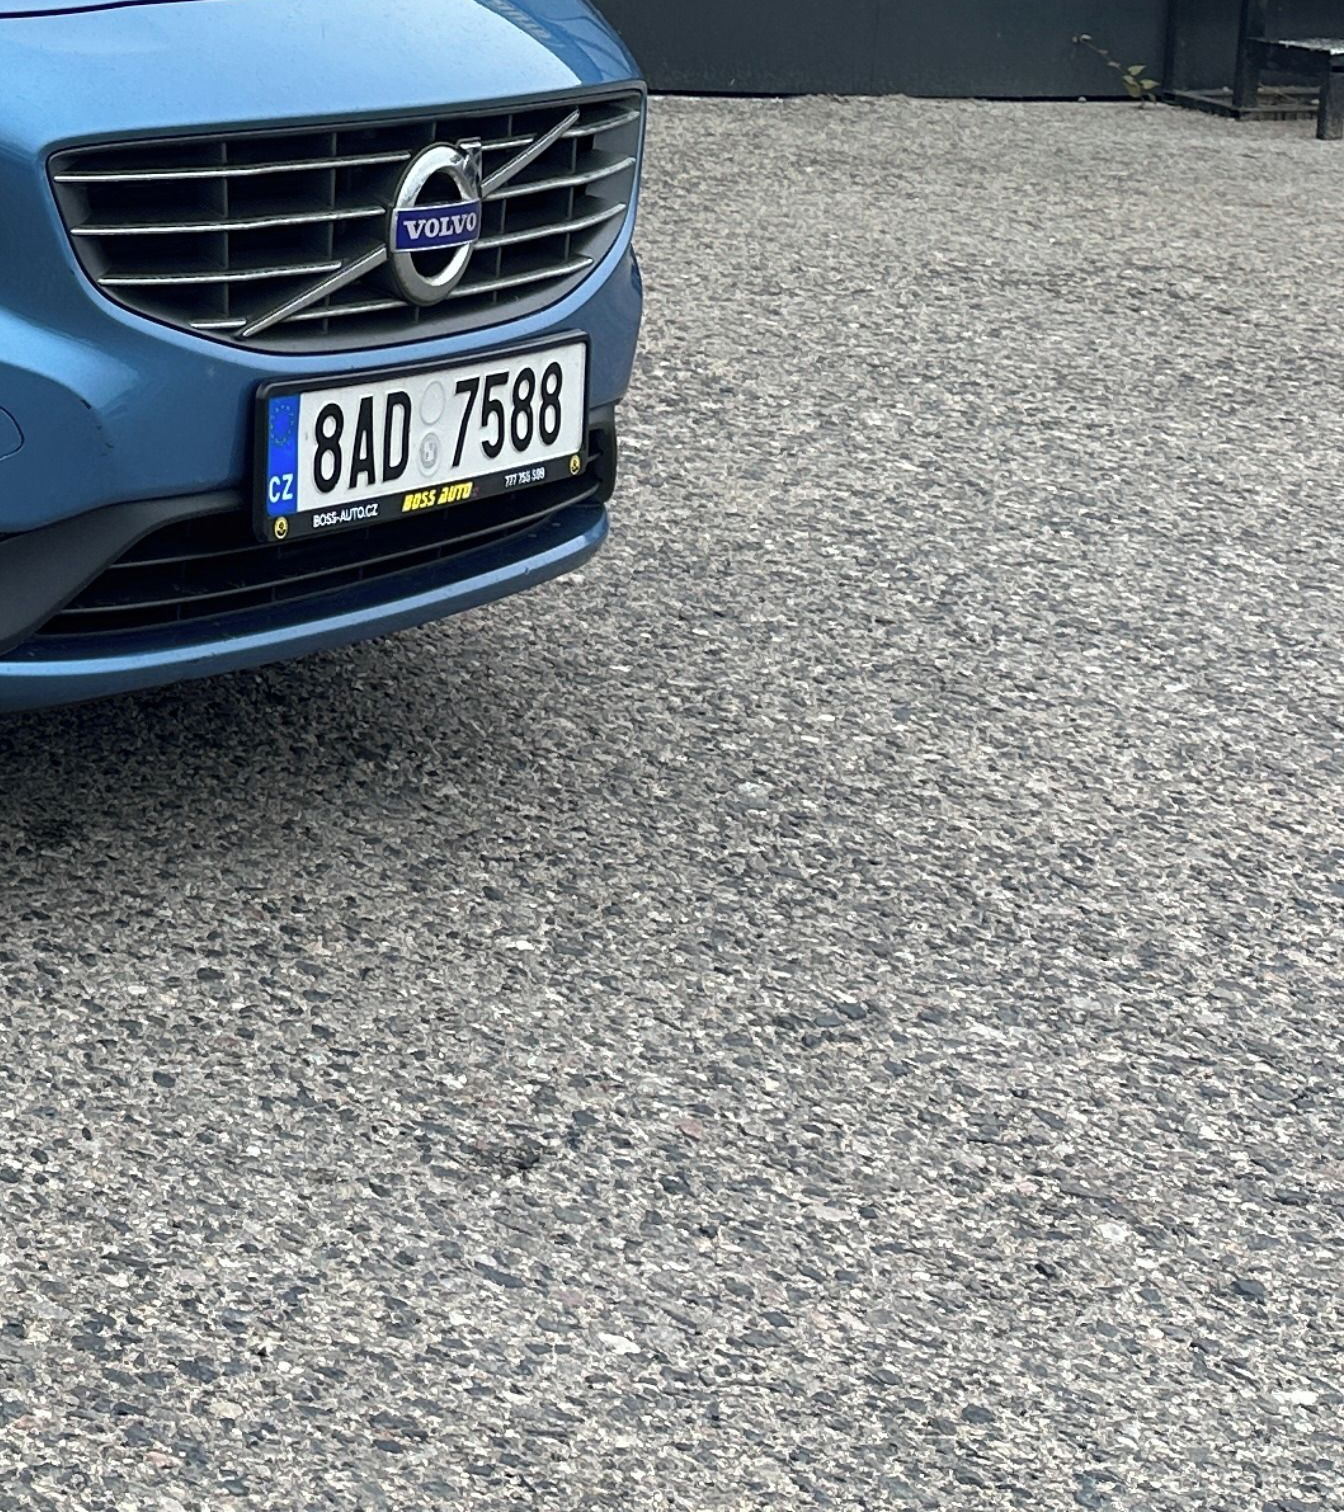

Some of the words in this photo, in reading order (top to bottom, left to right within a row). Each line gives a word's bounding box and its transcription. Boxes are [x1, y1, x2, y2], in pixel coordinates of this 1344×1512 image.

[402, 212, 477, 240] VOLVO
[313, 390, 412, 494] 8AD
[450, 361, 564, 469] 7588
[269, 473, 295, 505] CZ
[402, 487, 437, 513] BOSS
[439, 481, 473, 506] AUTO
[312, 503, 379, 529] BOSS-AUTO.CZ
